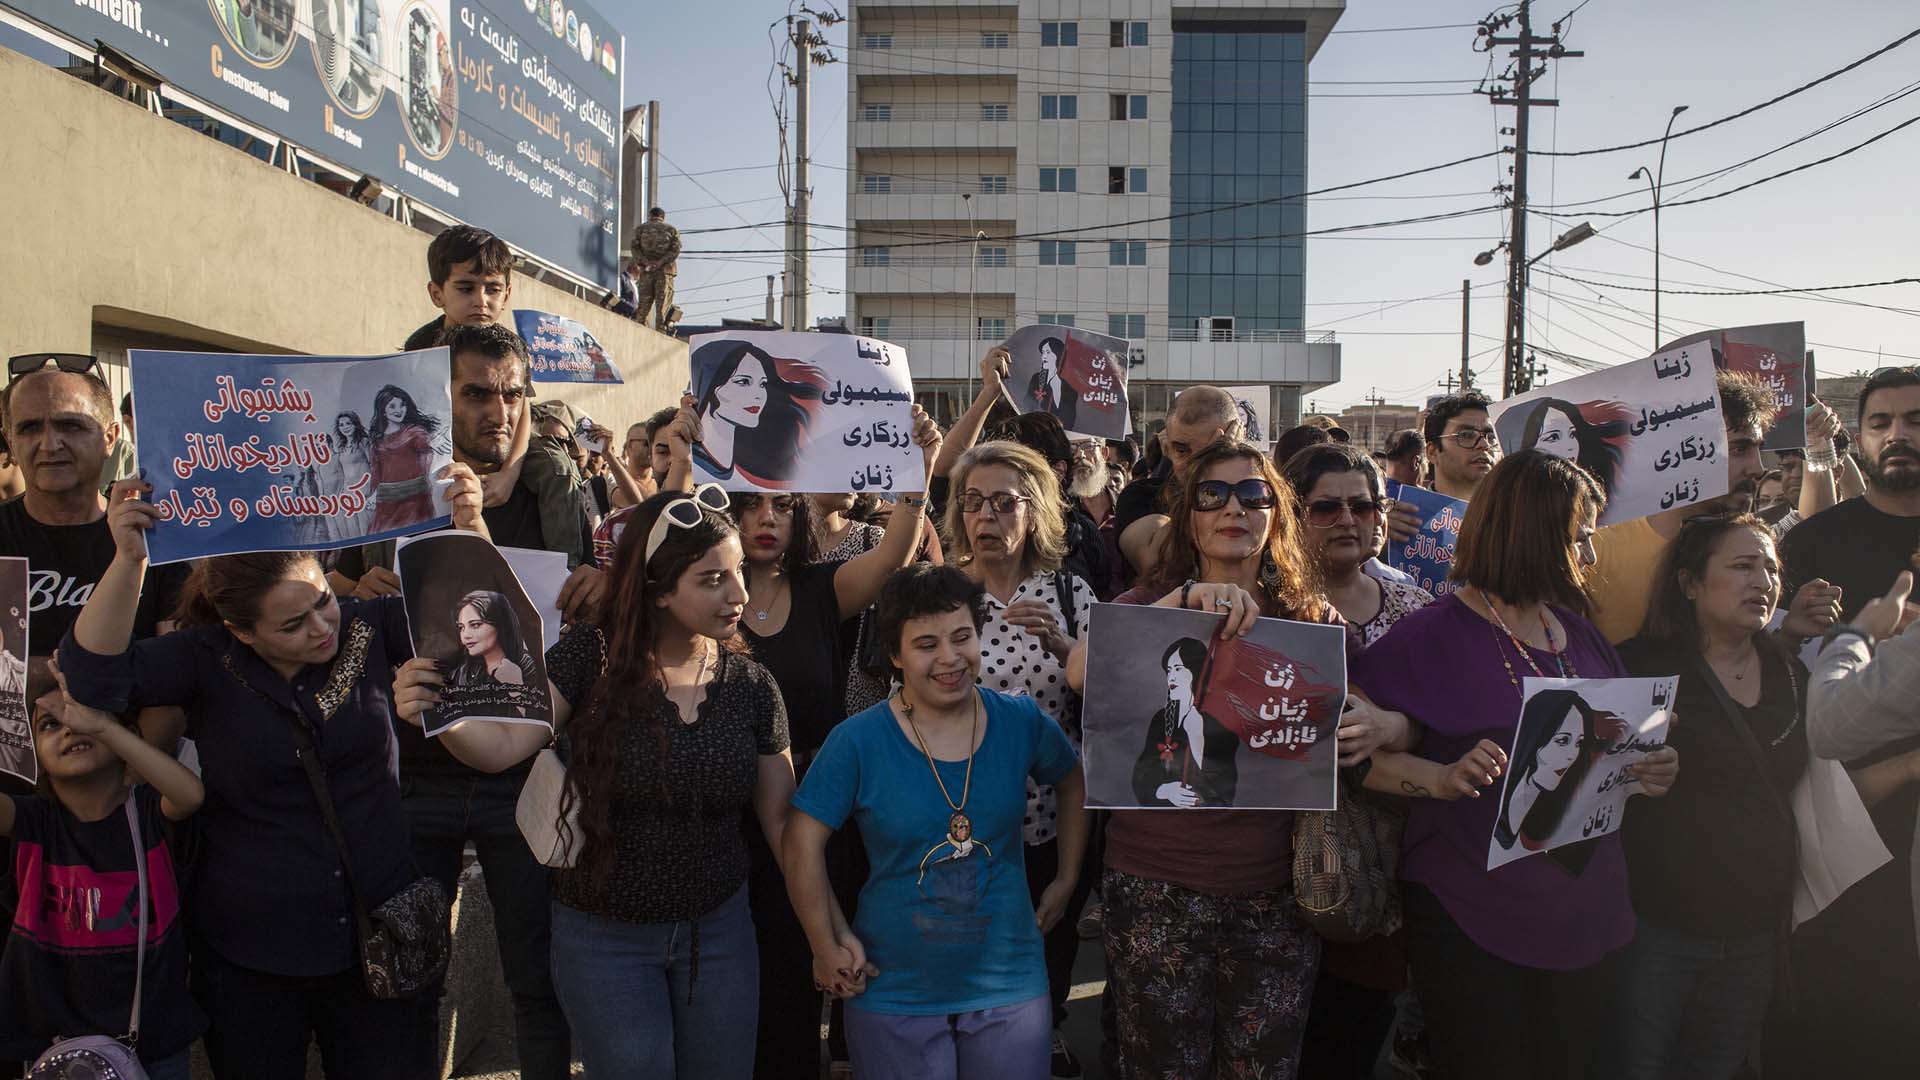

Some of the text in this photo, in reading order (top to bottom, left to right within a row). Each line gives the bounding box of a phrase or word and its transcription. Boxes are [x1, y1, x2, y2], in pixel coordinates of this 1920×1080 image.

[461, 7, 475, 37] بە
[480, 16, 518, 64] تایبەت
[211, 43, 290, 113] Construction show
[498, 83, 506, 111] و
[563, 131, 570, 155] و
[856, 339, 891, 367] ژینا
[1091, 356, 1106, 370] ژن
[1653, 351, 1691, 381] ژینا
[1759, 352, 1777, 371] ژن
[822, 380, 912, 407] سیمبولی
[1088, 373, 1113, 390] ژیان
[204, 375, 316, 423] پشتیوانی
[1083, 390, 1118, 407] ئازادی
[1630, 394, 1716, 437] سیمبولی
[173, 431, 332, 479] ئازادیخوازانی
[851, 464, 893, 491] ژنان
[154, 472, 371, 527] کوردستان و ئێران
[1660, 477, 1699, 510] ژنان
[1264, 663, 1295, 690] ژن
[1260, 696, 1309, 722] ژیان
[1652, 681, 1673, 711] ژینا
[1250, 725, 1317, 751] ئازادی
[1582, 805, 1613, 838] ژنان
